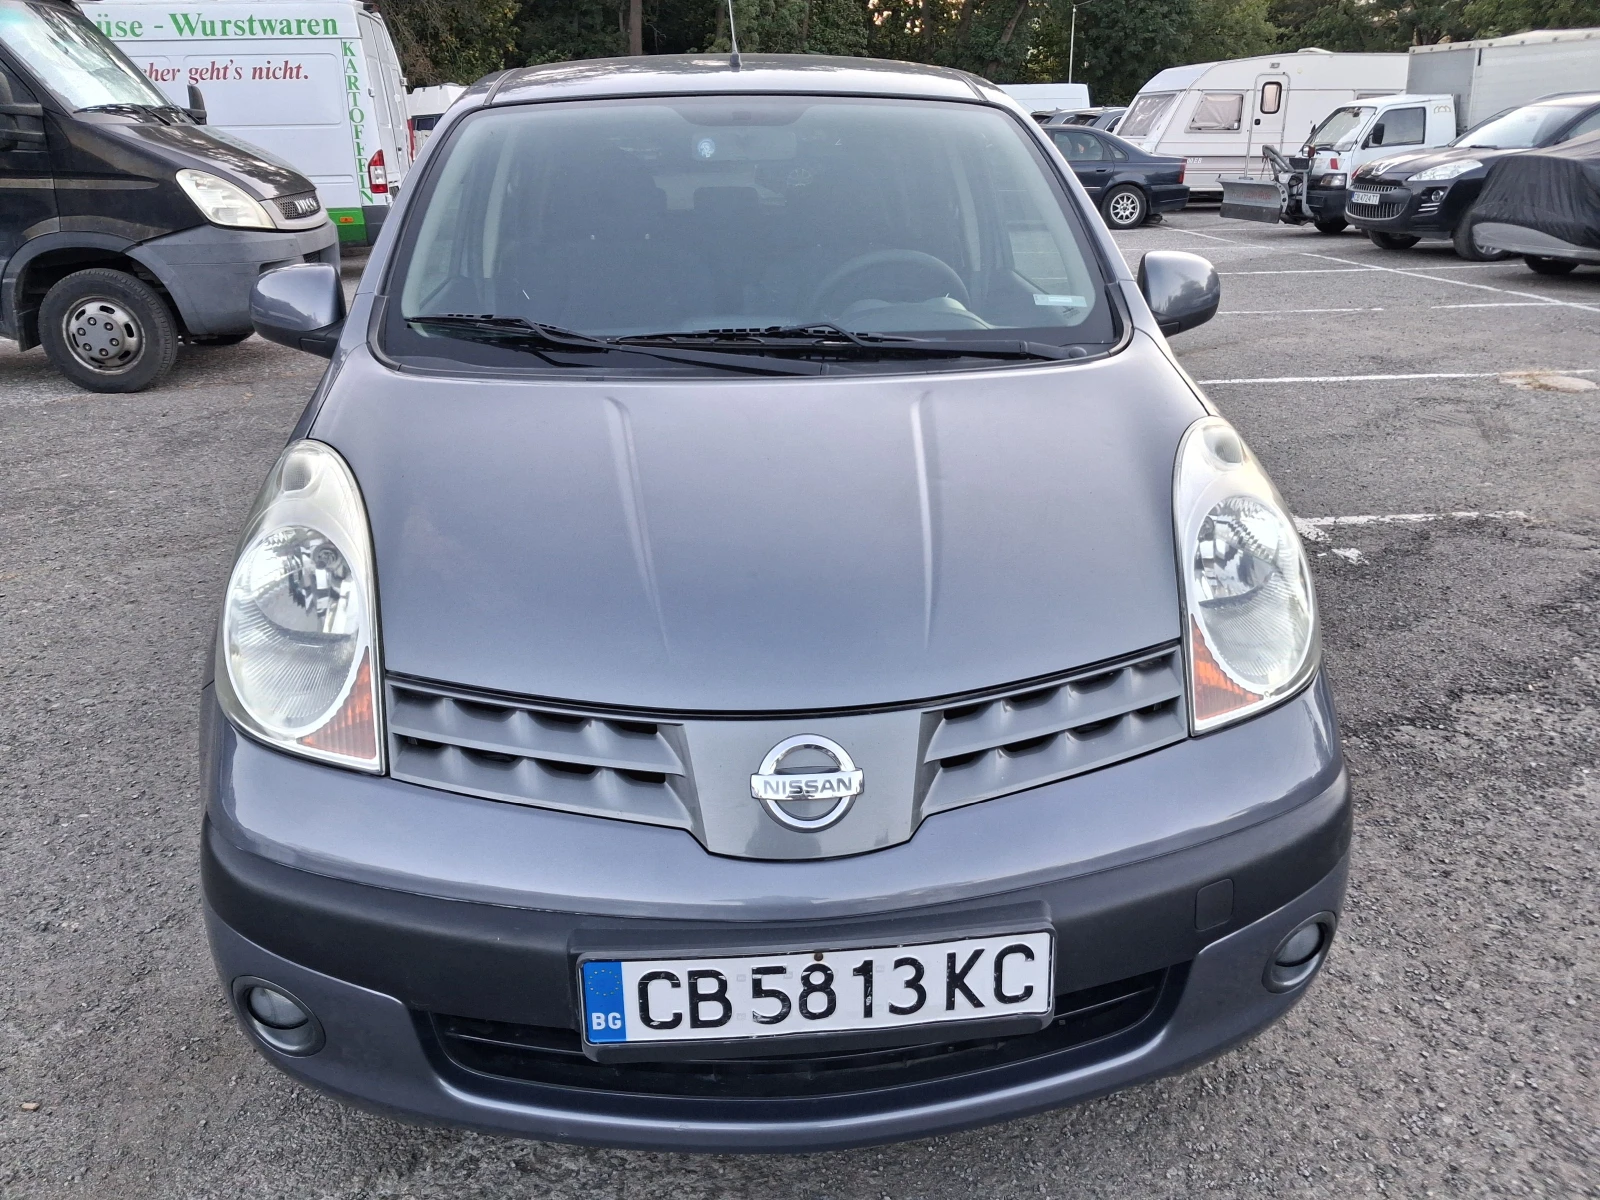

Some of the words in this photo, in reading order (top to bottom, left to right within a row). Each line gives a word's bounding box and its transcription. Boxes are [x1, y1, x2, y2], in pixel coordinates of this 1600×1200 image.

[168, 13, 339, 37] Wurstwaren
[188, 59, 243, 86] geht's
[251, 60, 309, 81] nicht.
[342, 41, 374, 204] KARTOFFELN
[762, 776, 853, 796] NISSAN
[591, 1011, 622, 1030] BG
